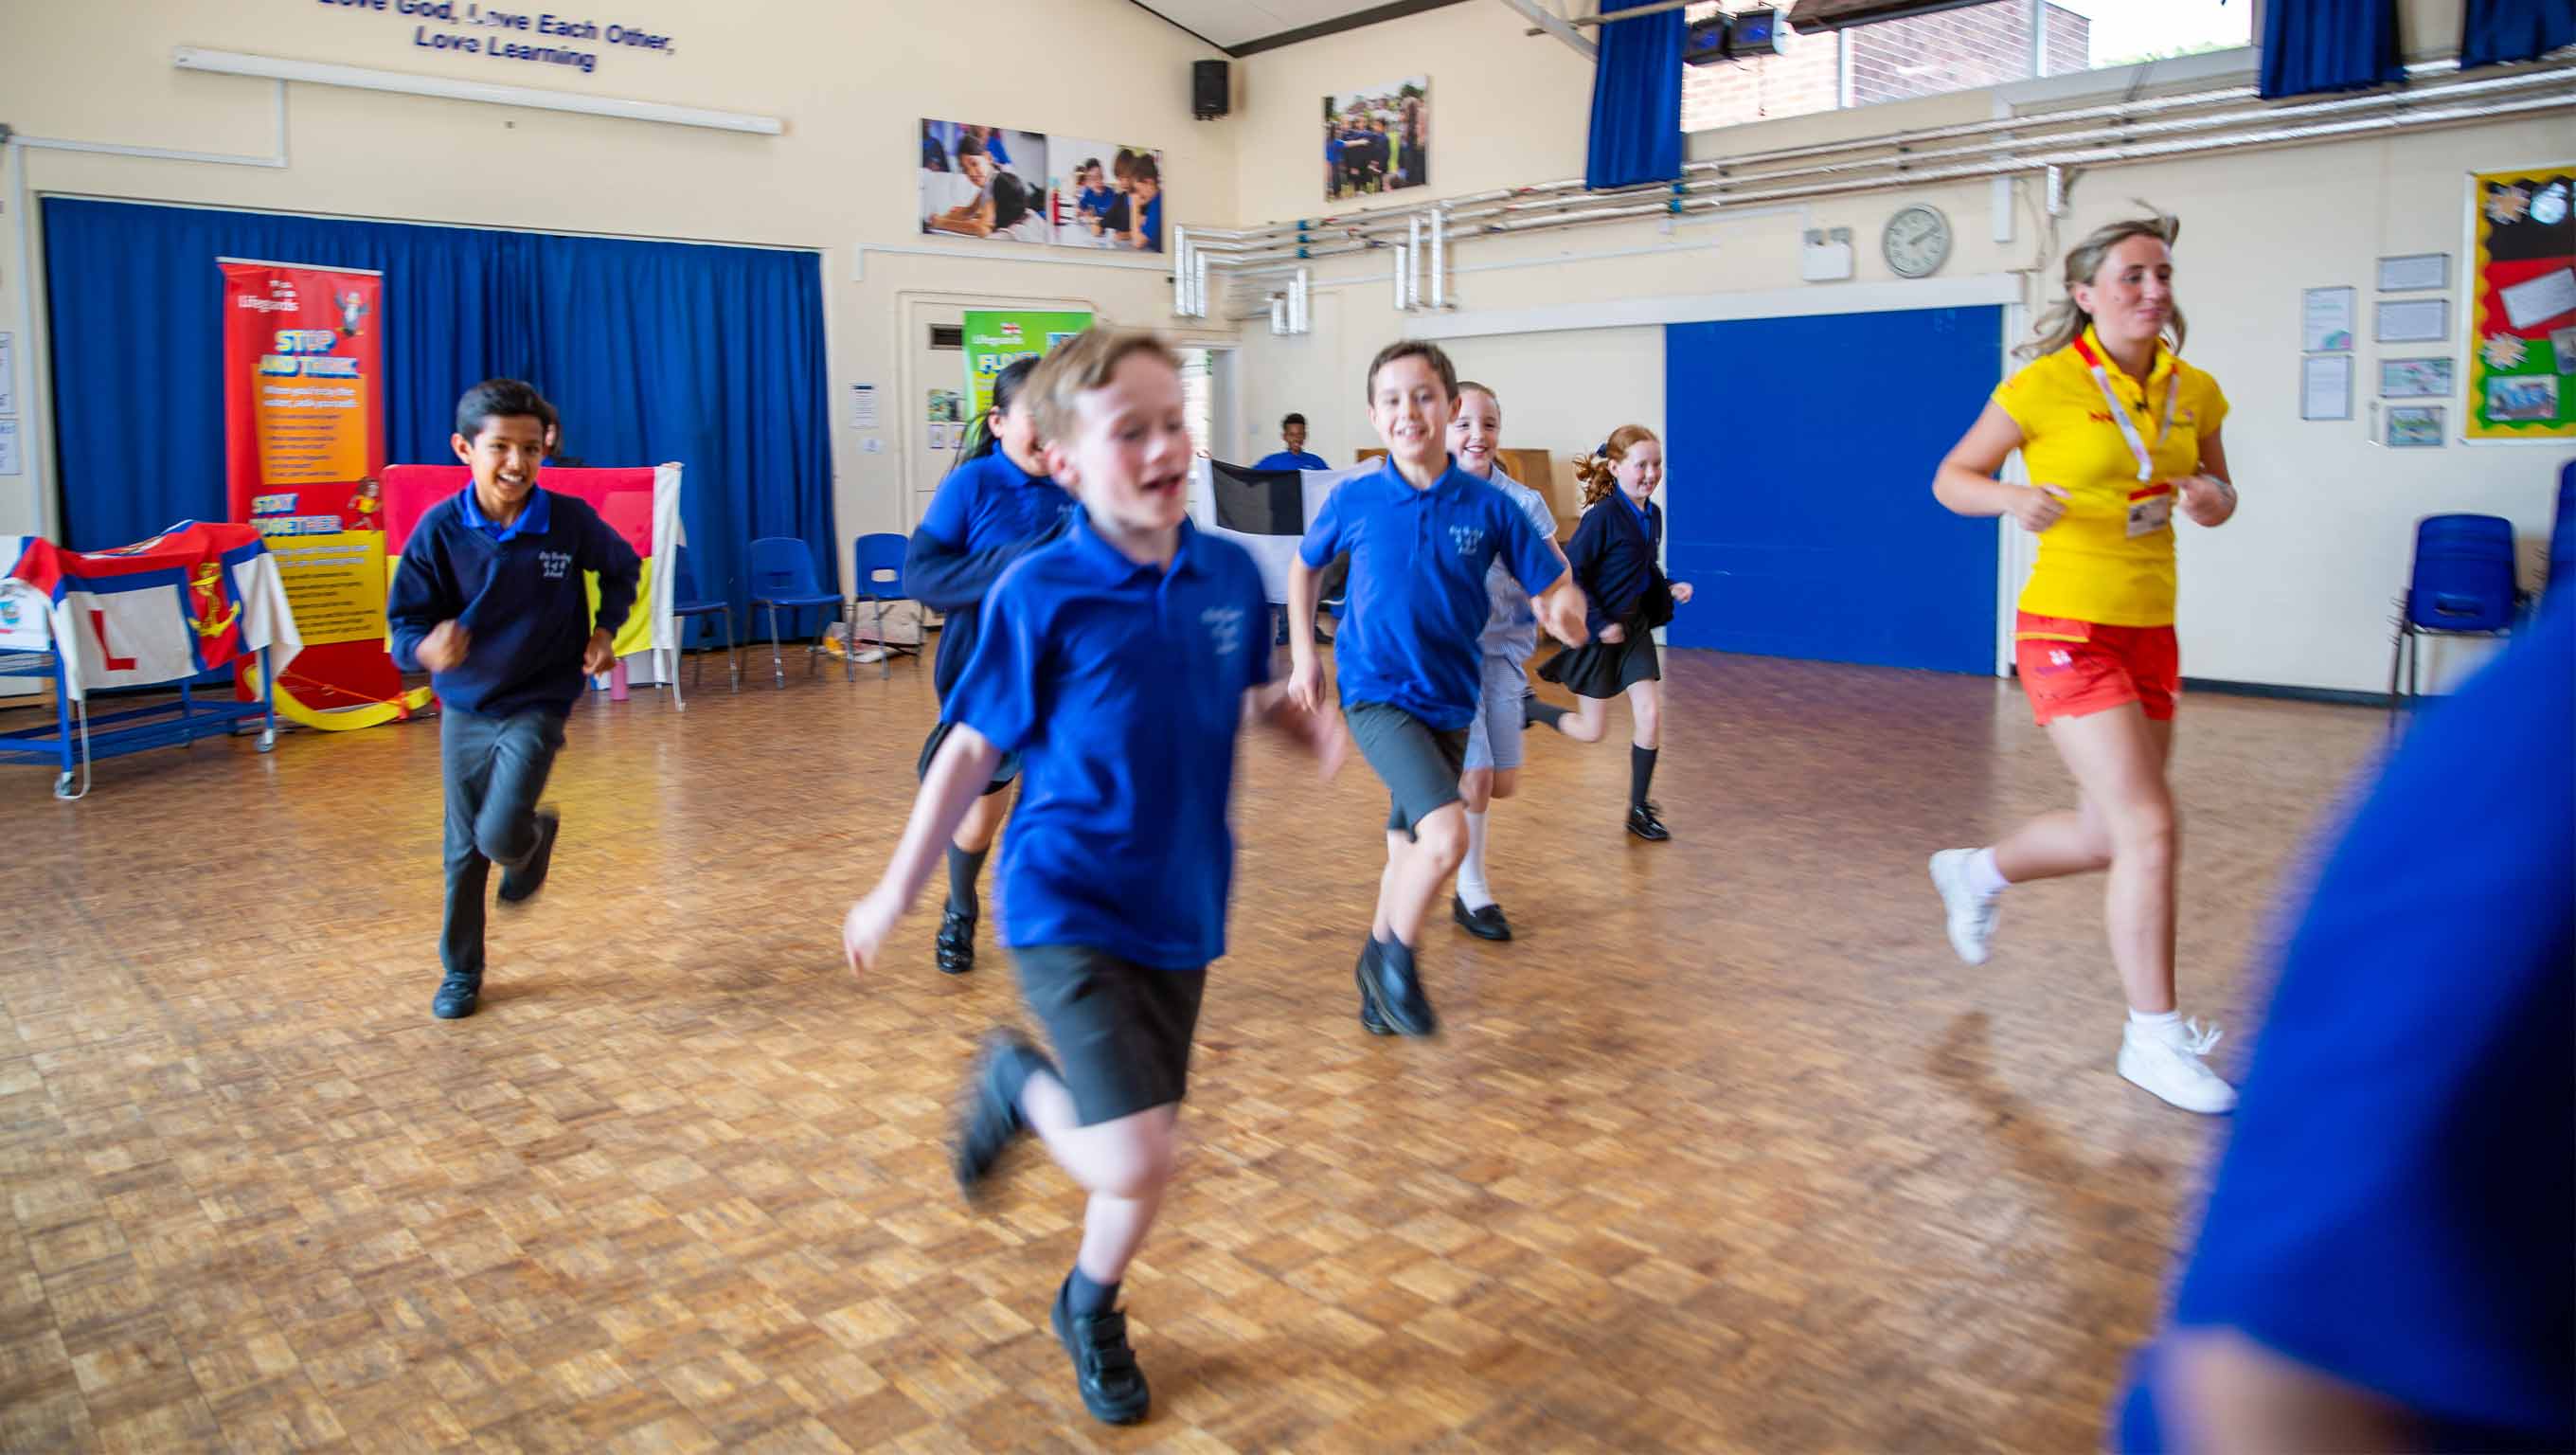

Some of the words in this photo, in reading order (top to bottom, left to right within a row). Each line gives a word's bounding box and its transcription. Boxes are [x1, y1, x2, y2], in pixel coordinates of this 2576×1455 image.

[415, 26, 479, 53] Love
[488, 35, 597, 73] Learning
[538, 14, 598, 40] Each
[605, 25, 674, 55] Other,
[275, 330, 337, 355] STOP
